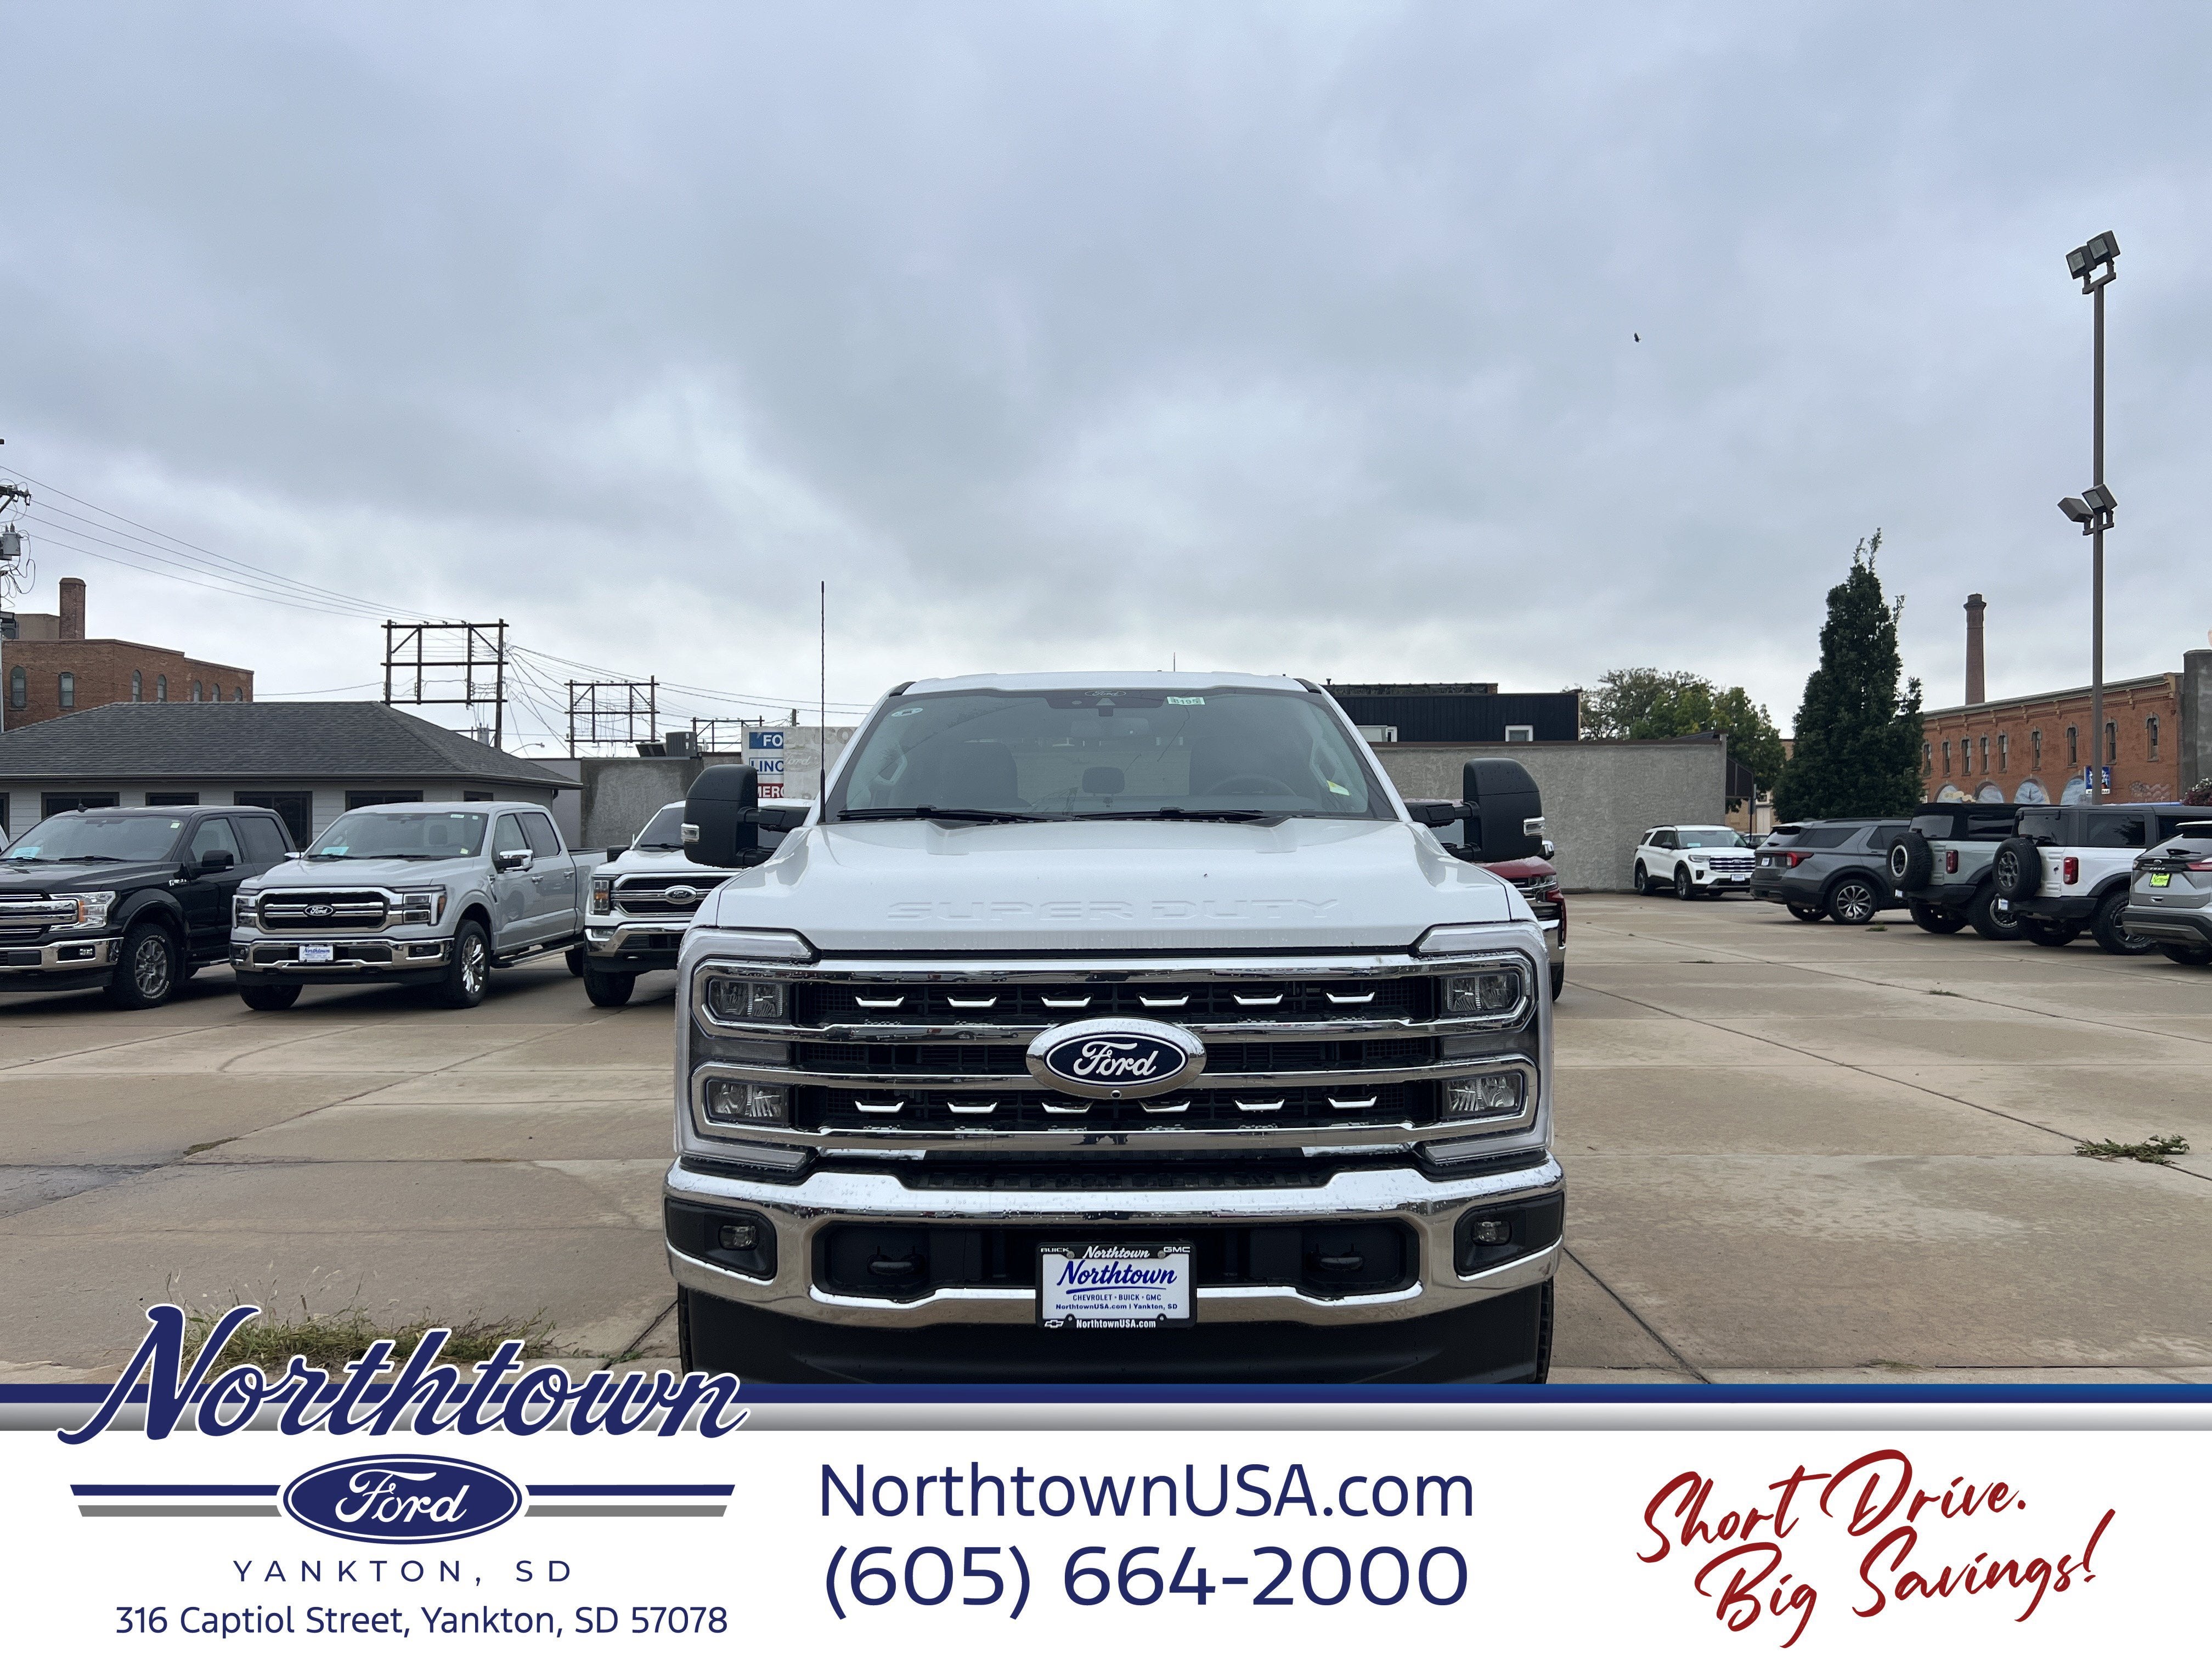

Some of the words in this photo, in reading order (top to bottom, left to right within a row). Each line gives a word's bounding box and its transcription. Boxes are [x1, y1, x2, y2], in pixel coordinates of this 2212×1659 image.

[763, 734, 783, 747] FO
[887, 901, 1133, 921] SUPER
[1152, 899, 1339, 919] DUTY
[1073, 1041, 1159, 1076] Ford
[1082, 1245, 1150, 1259] Northtown
[1057, 1260, 1177, 1285] Northtown
[1076, 1319, 1156, 1329] NorthtownUSA.com
